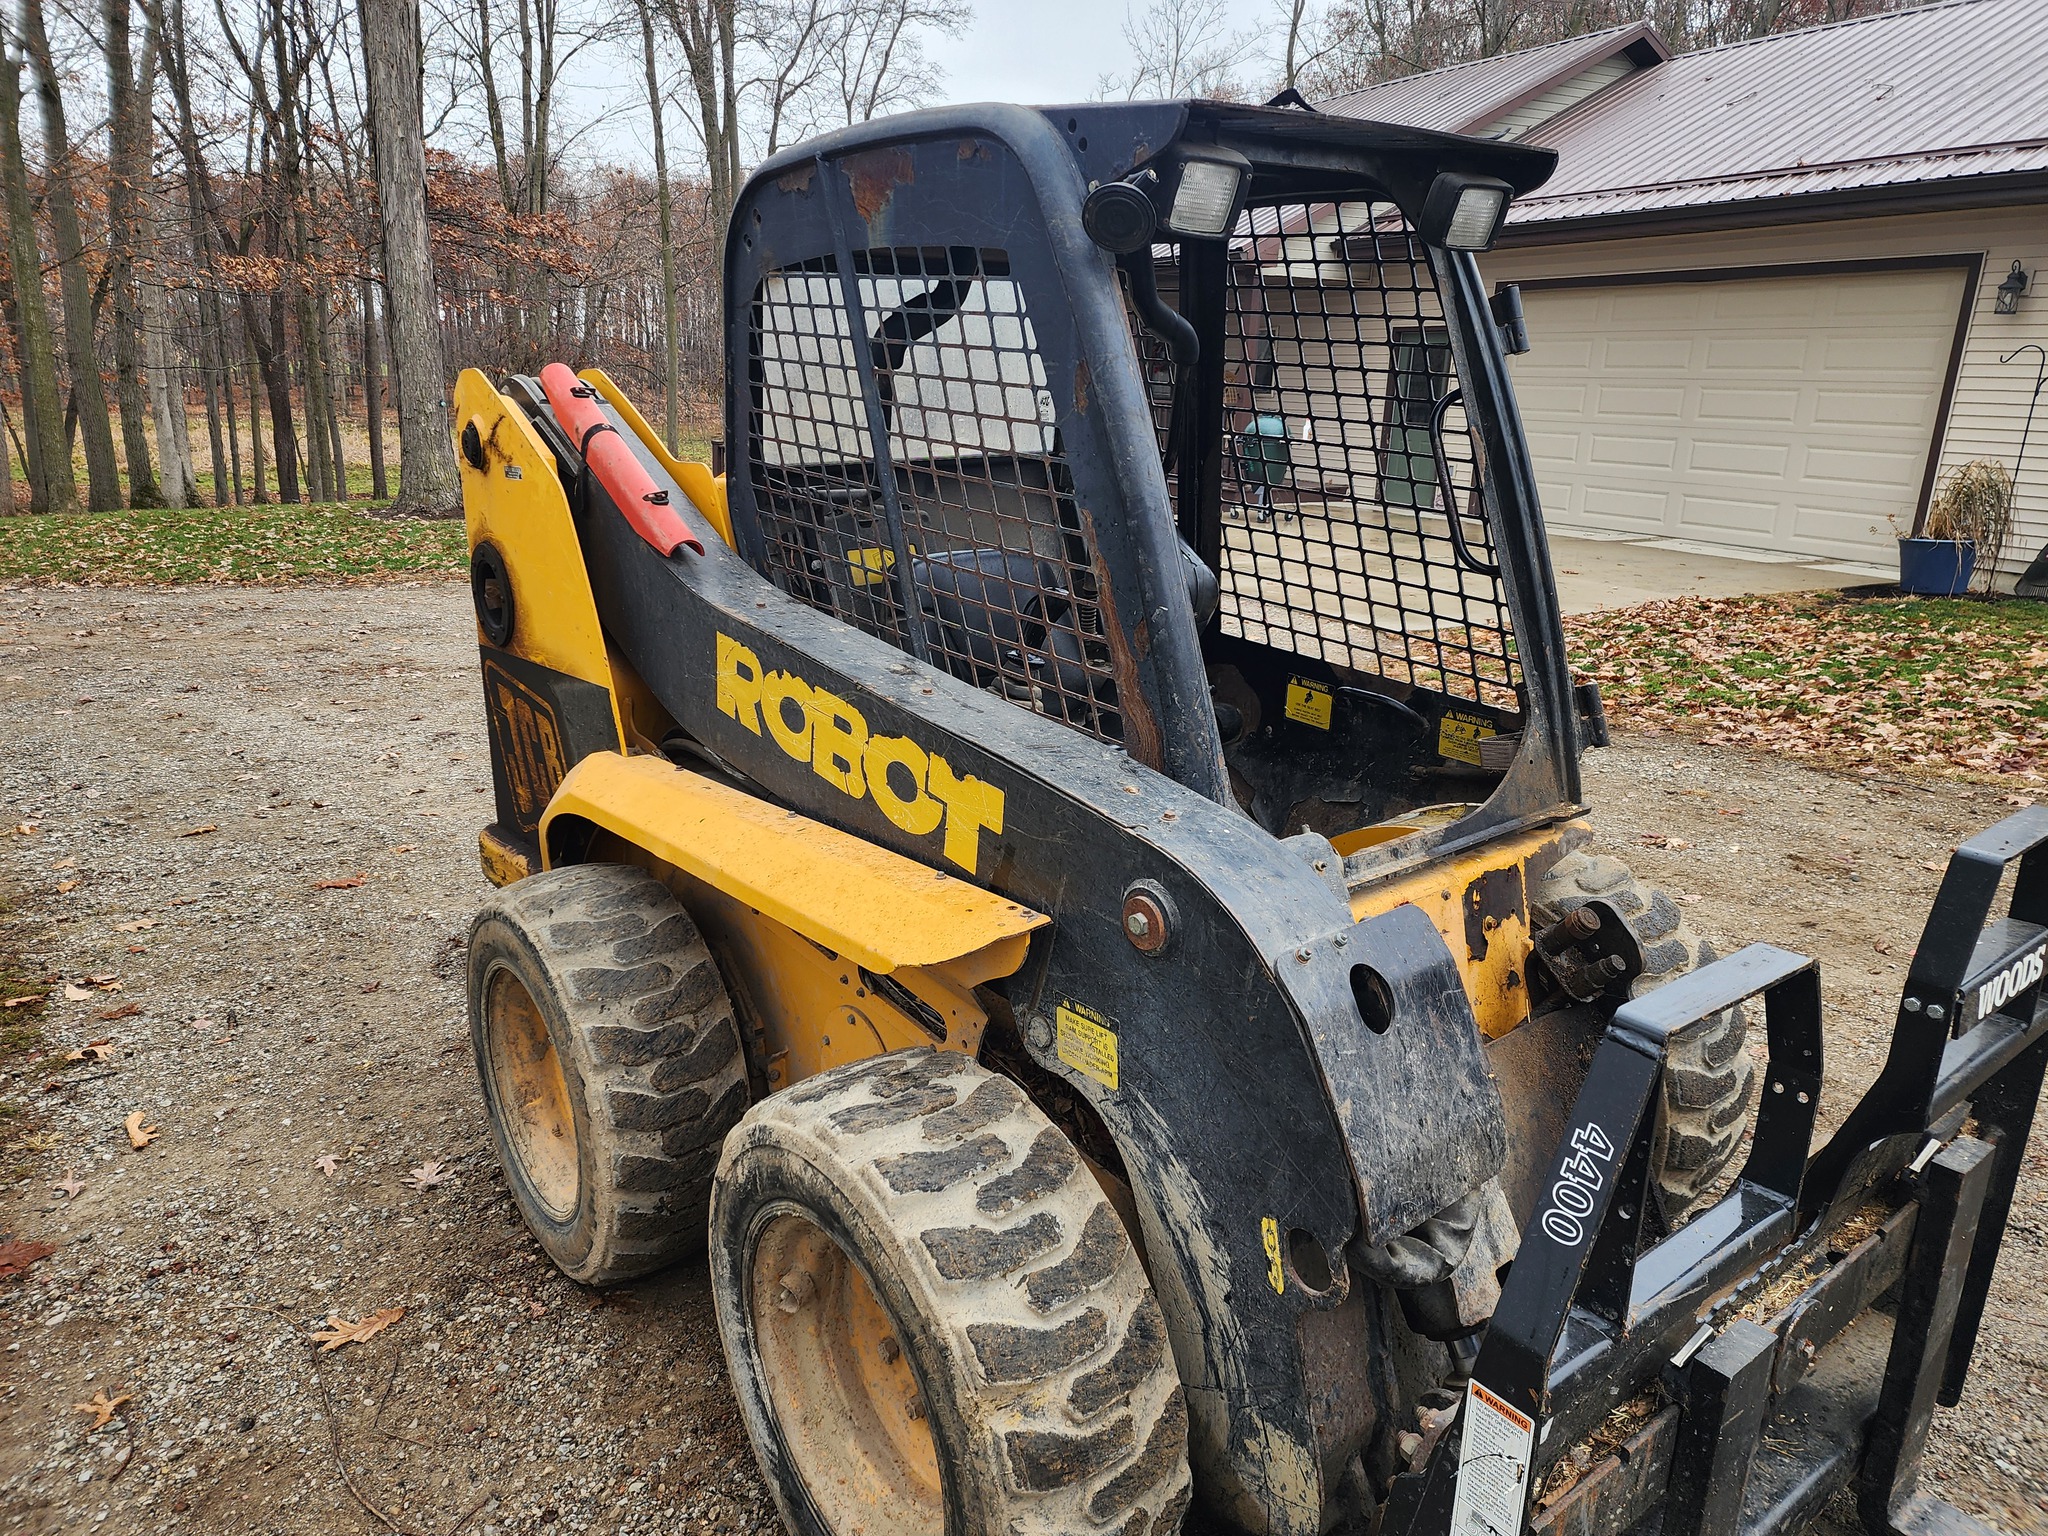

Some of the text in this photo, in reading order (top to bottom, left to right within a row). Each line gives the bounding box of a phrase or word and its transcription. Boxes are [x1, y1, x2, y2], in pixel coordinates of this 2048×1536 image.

[1301, 678, 1329, 693] WARNING
[1455, 711, 1494, 729] WARNING
[496, 682, 563, 814] JCB
[716, 631, 1005, 876] ROBOT
[1977, 943, 2047, 1020] WOODS
[1065, 1014, 1107, 1040] MAKE SURE LIFT
[1075, 1002, 1110, 1027] WARNING
[1542, 1122, 1614, 1246] 4400
[1476, 1406, 1493, 1421] INJURY
[1494, 1418, 1502, 1427] OR
[1476, 1400, 1523, 1436] TO AVOID SERIOUS
[1484, 1394, 1527, 1429] WARNING
